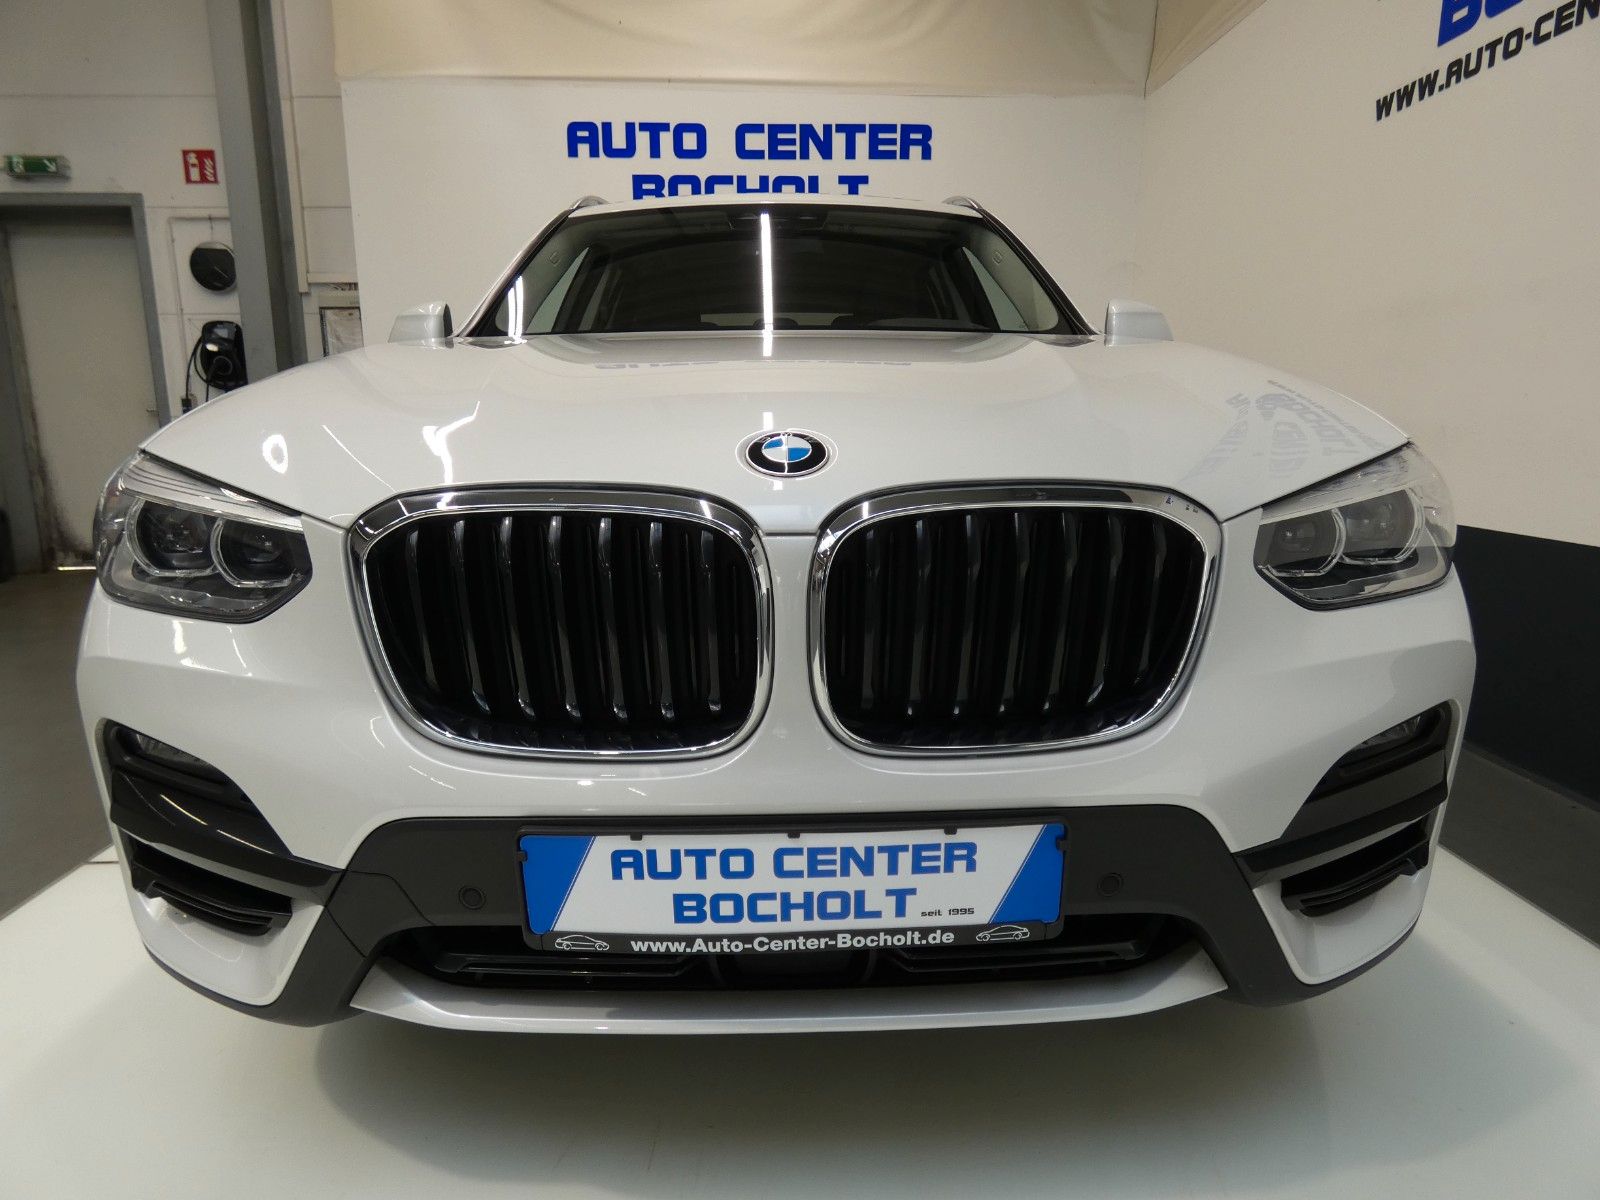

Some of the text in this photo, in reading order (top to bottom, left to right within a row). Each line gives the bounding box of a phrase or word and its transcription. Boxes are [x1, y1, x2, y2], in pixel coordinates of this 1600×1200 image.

[567, 121, 932, 160] AUTO CENTER
[611, 842, 978, 880] AUTO CENTER
[673, 888, 917, 923] BOCHOLT
[921, 907, 975, 917] seit 1995
[630, 930, 955, 953] www.Auto-Center-Bocholt.de
